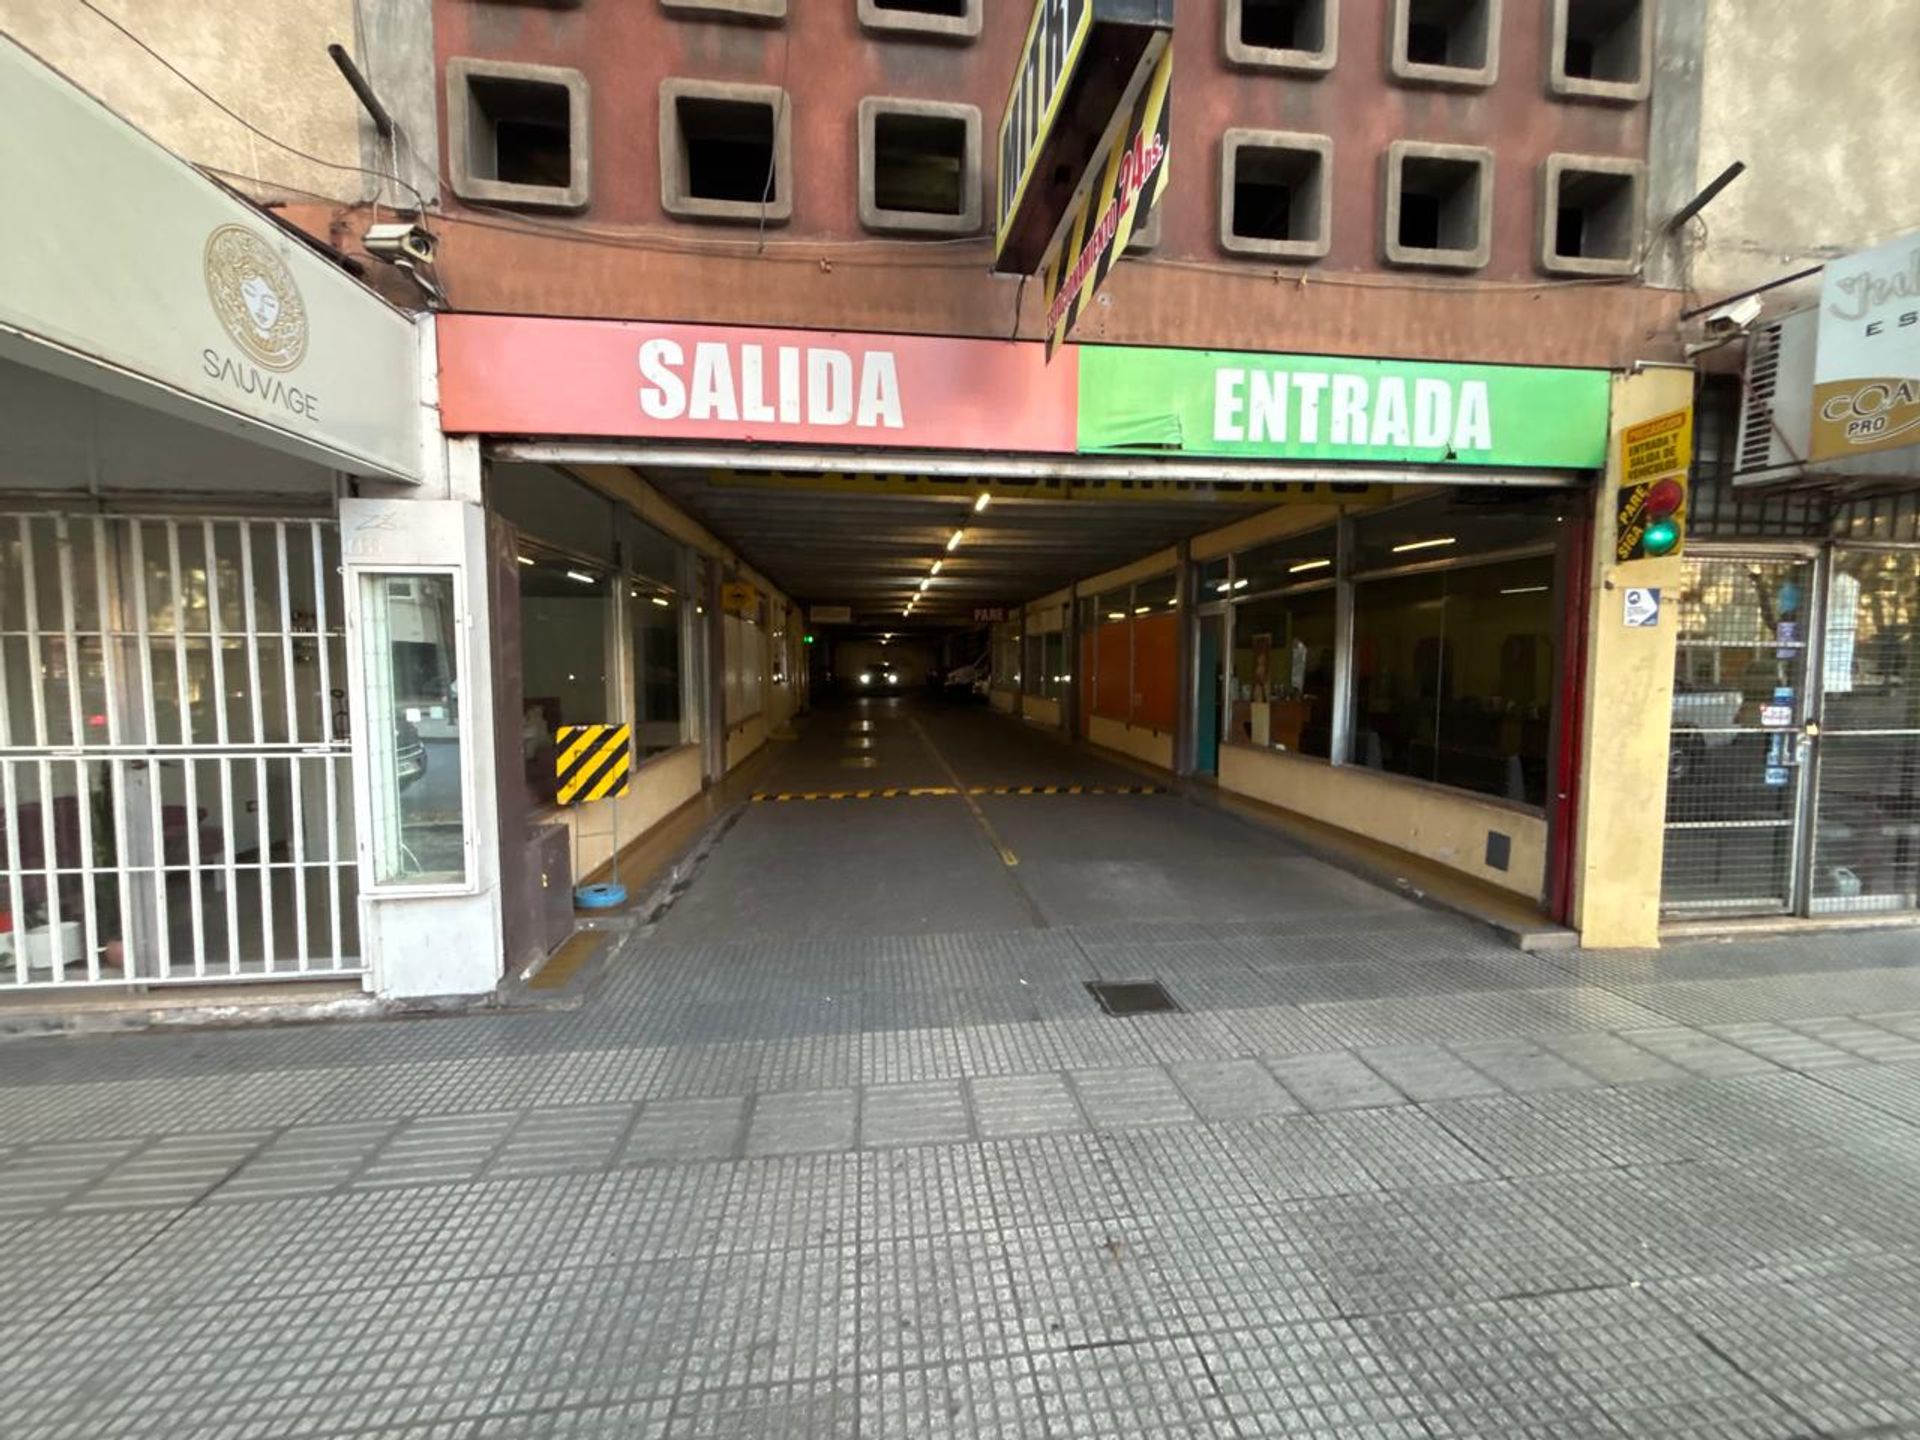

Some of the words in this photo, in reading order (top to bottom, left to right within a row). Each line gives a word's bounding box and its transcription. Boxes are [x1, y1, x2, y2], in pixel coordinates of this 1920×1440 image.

[203, 348, 320, 422] SAUVAGE
[639, 338, 904, 428] SALIDA
[1213, 367, 1493, 451] ENTRADA
[1847, 416, 1886, 436] PRO
[1629, 434, 1669, 457] ENTRADA
[1629, 449, 1660, 468] SALIDA
[1619, 486, 1648, 525] PARE
[1618, 525, 1644, 560] SIGA
